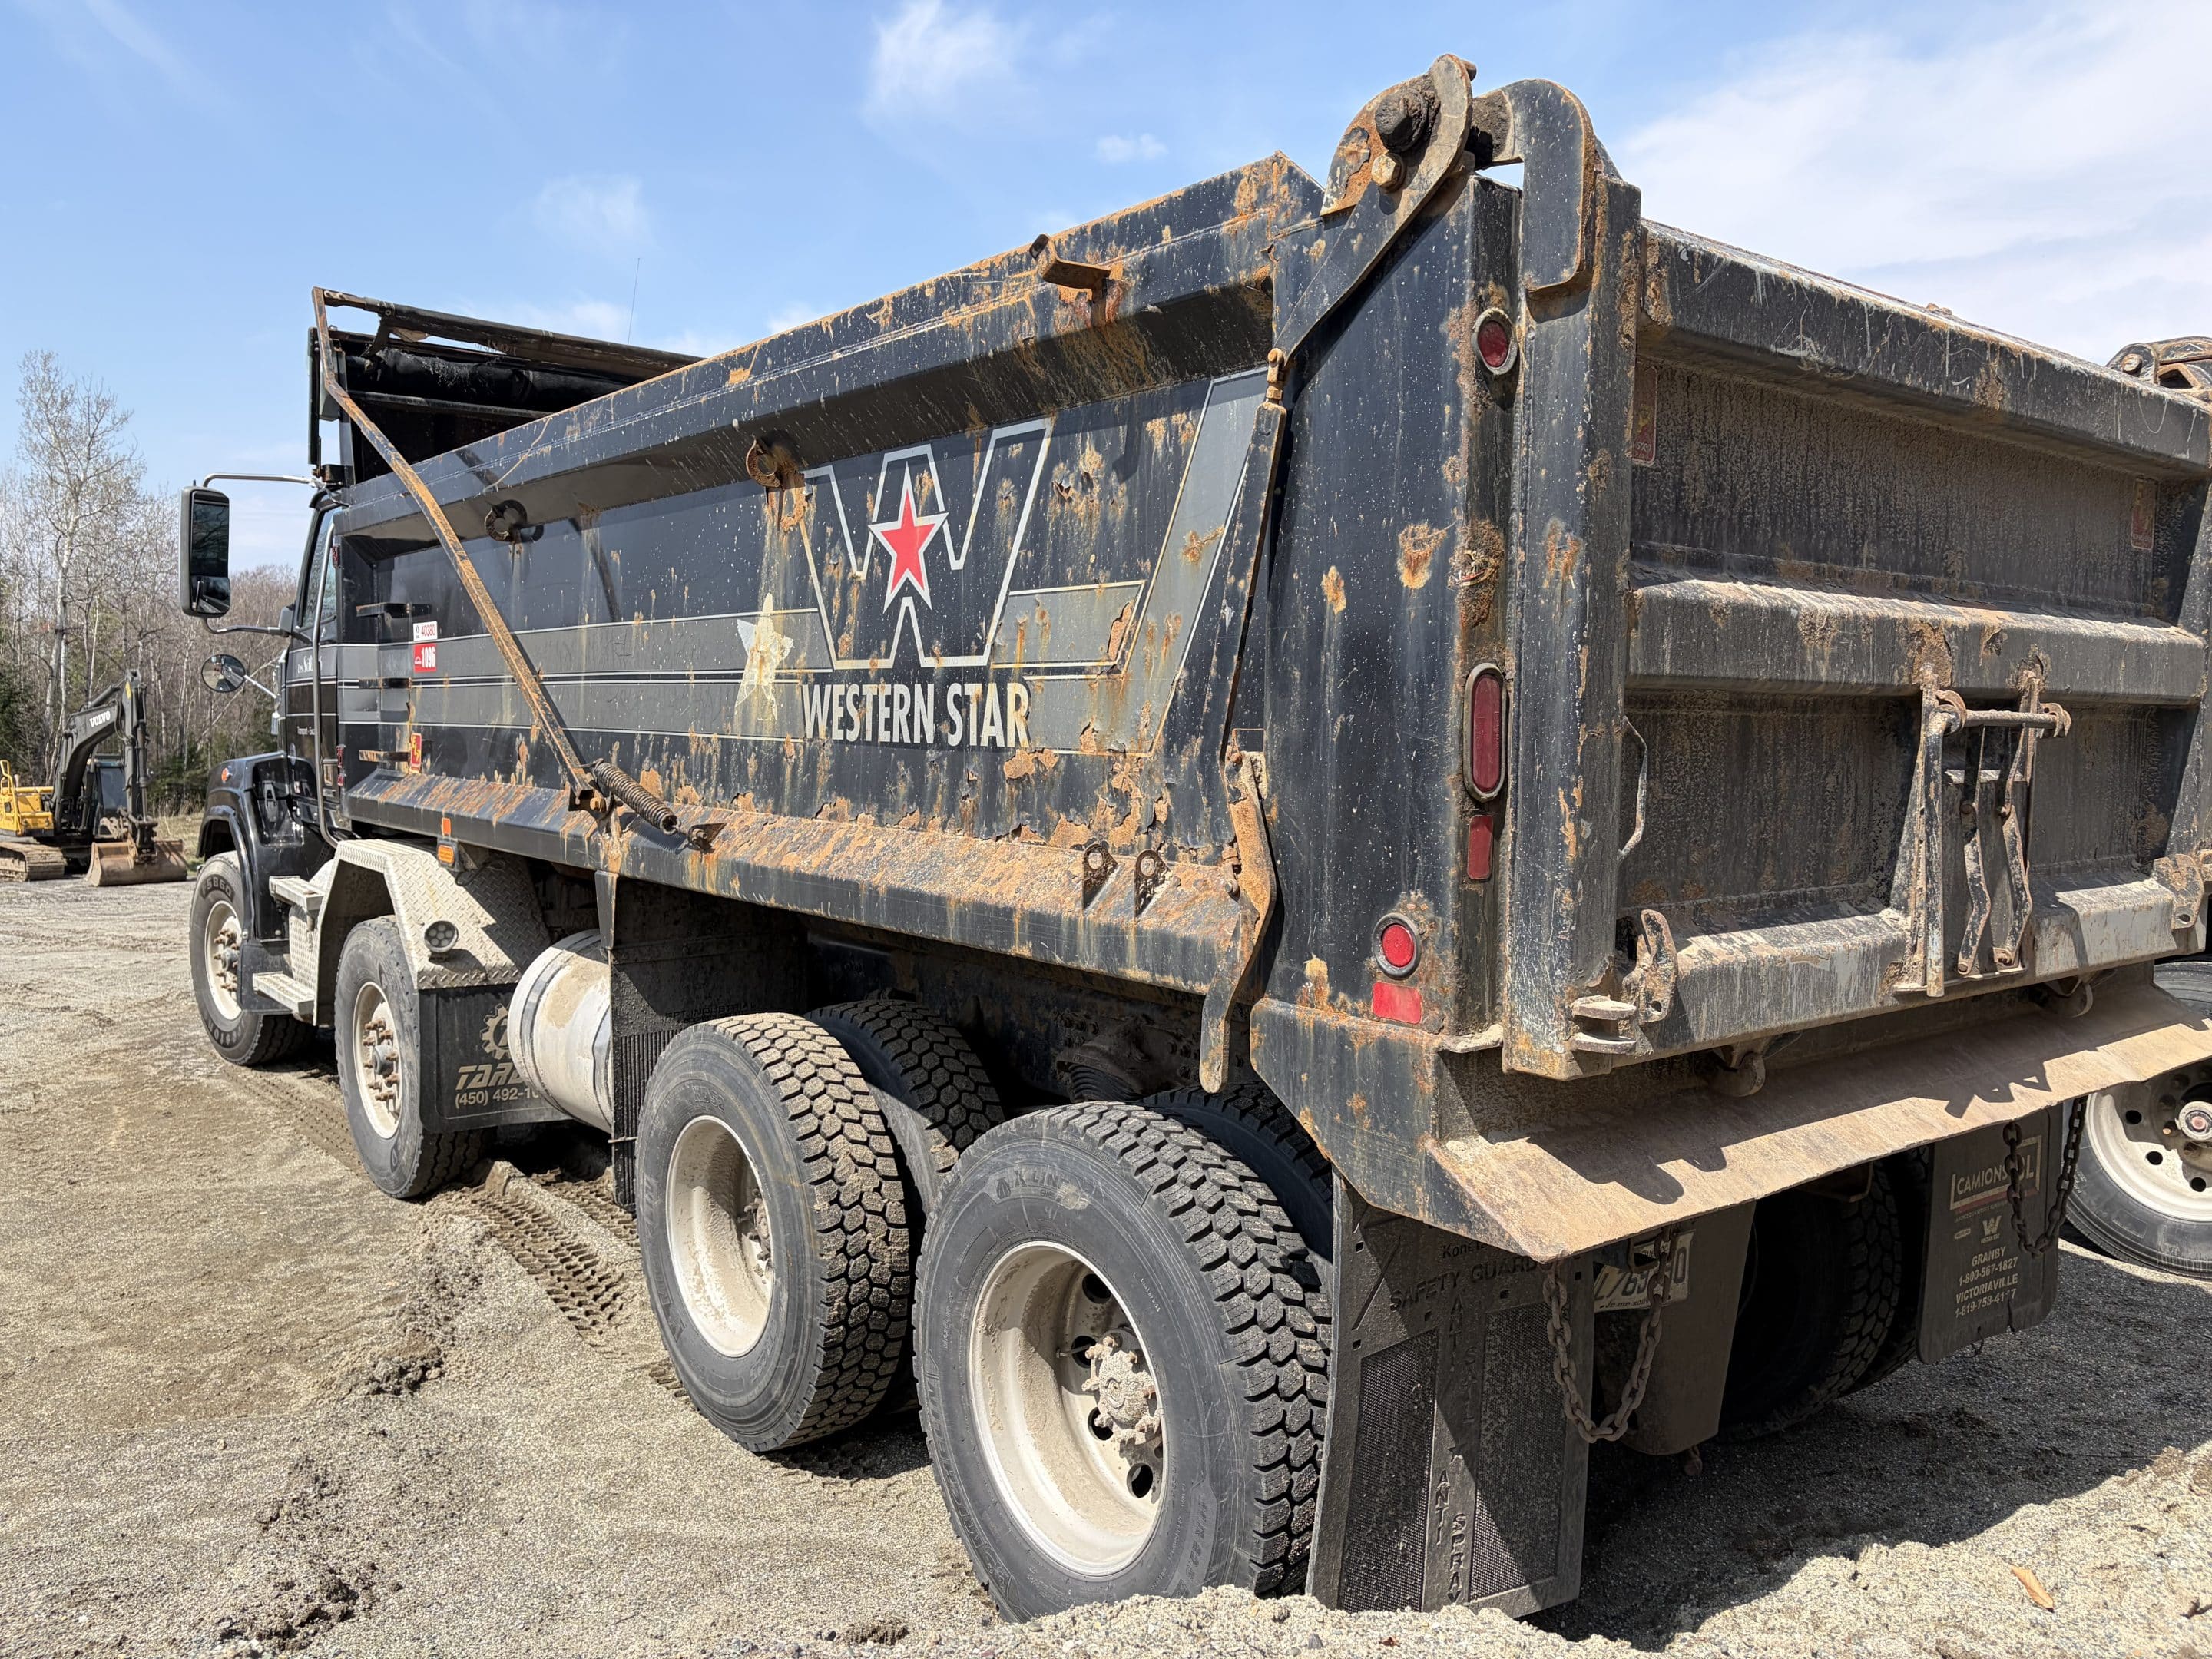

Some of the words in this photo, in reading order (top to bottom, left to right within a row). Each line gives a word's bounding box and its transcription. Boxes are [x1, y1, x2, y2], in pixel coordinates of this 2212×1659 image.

[89, 710, 111, 727] VOLVO
[801, 682, 934, 744] WESTERN
[947, 681, 1030, 748] STAR
[455, 1090, 489, 1109] (450)
[1957, 1164, 2008, 1195] CAMIONS
[1959, 1256, 2019, 1287] 1-800-567-1827
[1972, 1246, 2007, 1267] GRANBY
[1391, 1272, 1459, 1310] SAFETY
[1472, 1257, 1538, 1283] GUARD
[1955, 1273, 2019, 1304] VICTORIAVILLE
[1435, 1469, 1451, 1546] ANTI
[1447, 1512, 1467, 1604] SPRAY
